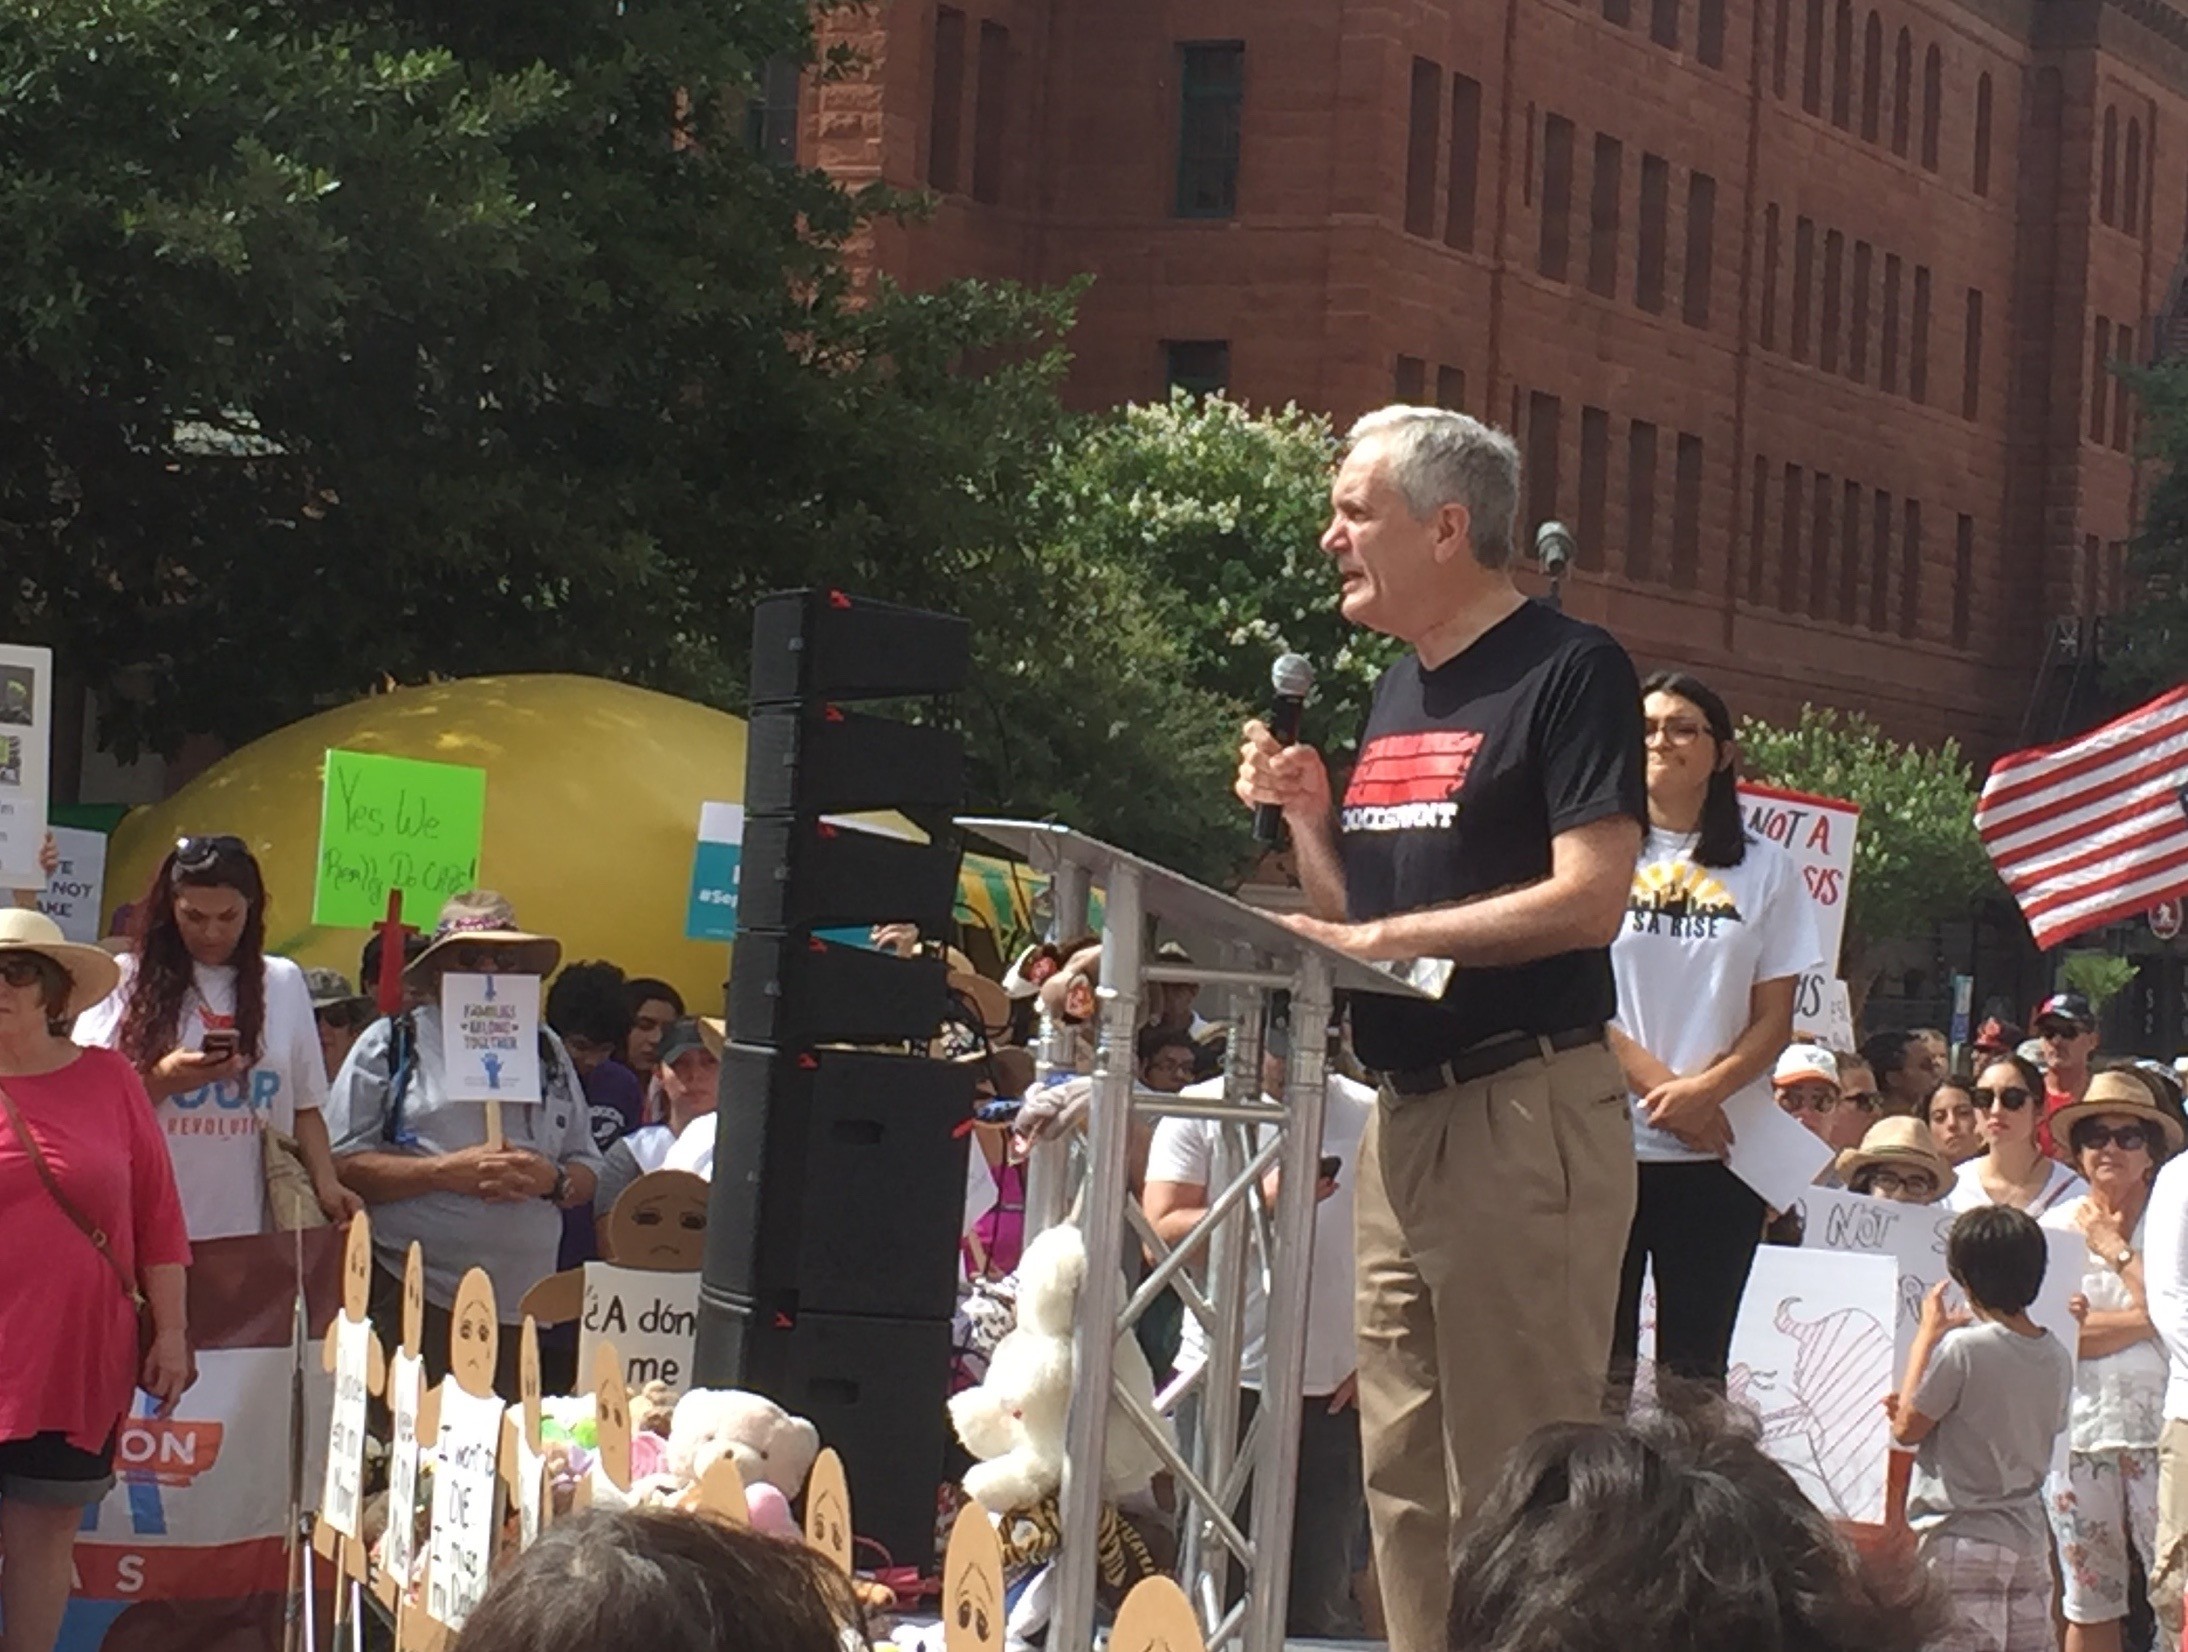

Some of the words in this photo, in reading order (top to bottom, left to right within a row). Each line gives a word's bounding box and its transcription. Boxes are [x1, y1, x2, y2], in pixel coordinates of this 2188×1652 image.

[338, 765, 384, 837] Yes
[397, 789, 440, 839] We
[1747, 806, 1809, 849] NOT
[1806, 814, 1832, 856] A
[51, 880, 94, 898] NOT
[1670, 914, 1718, 939] RISE
[1826, 1201, 1900, 1249] NOT
[626, 1357, 680, 1386] me
[121, 1428, 197, 1466] ON
